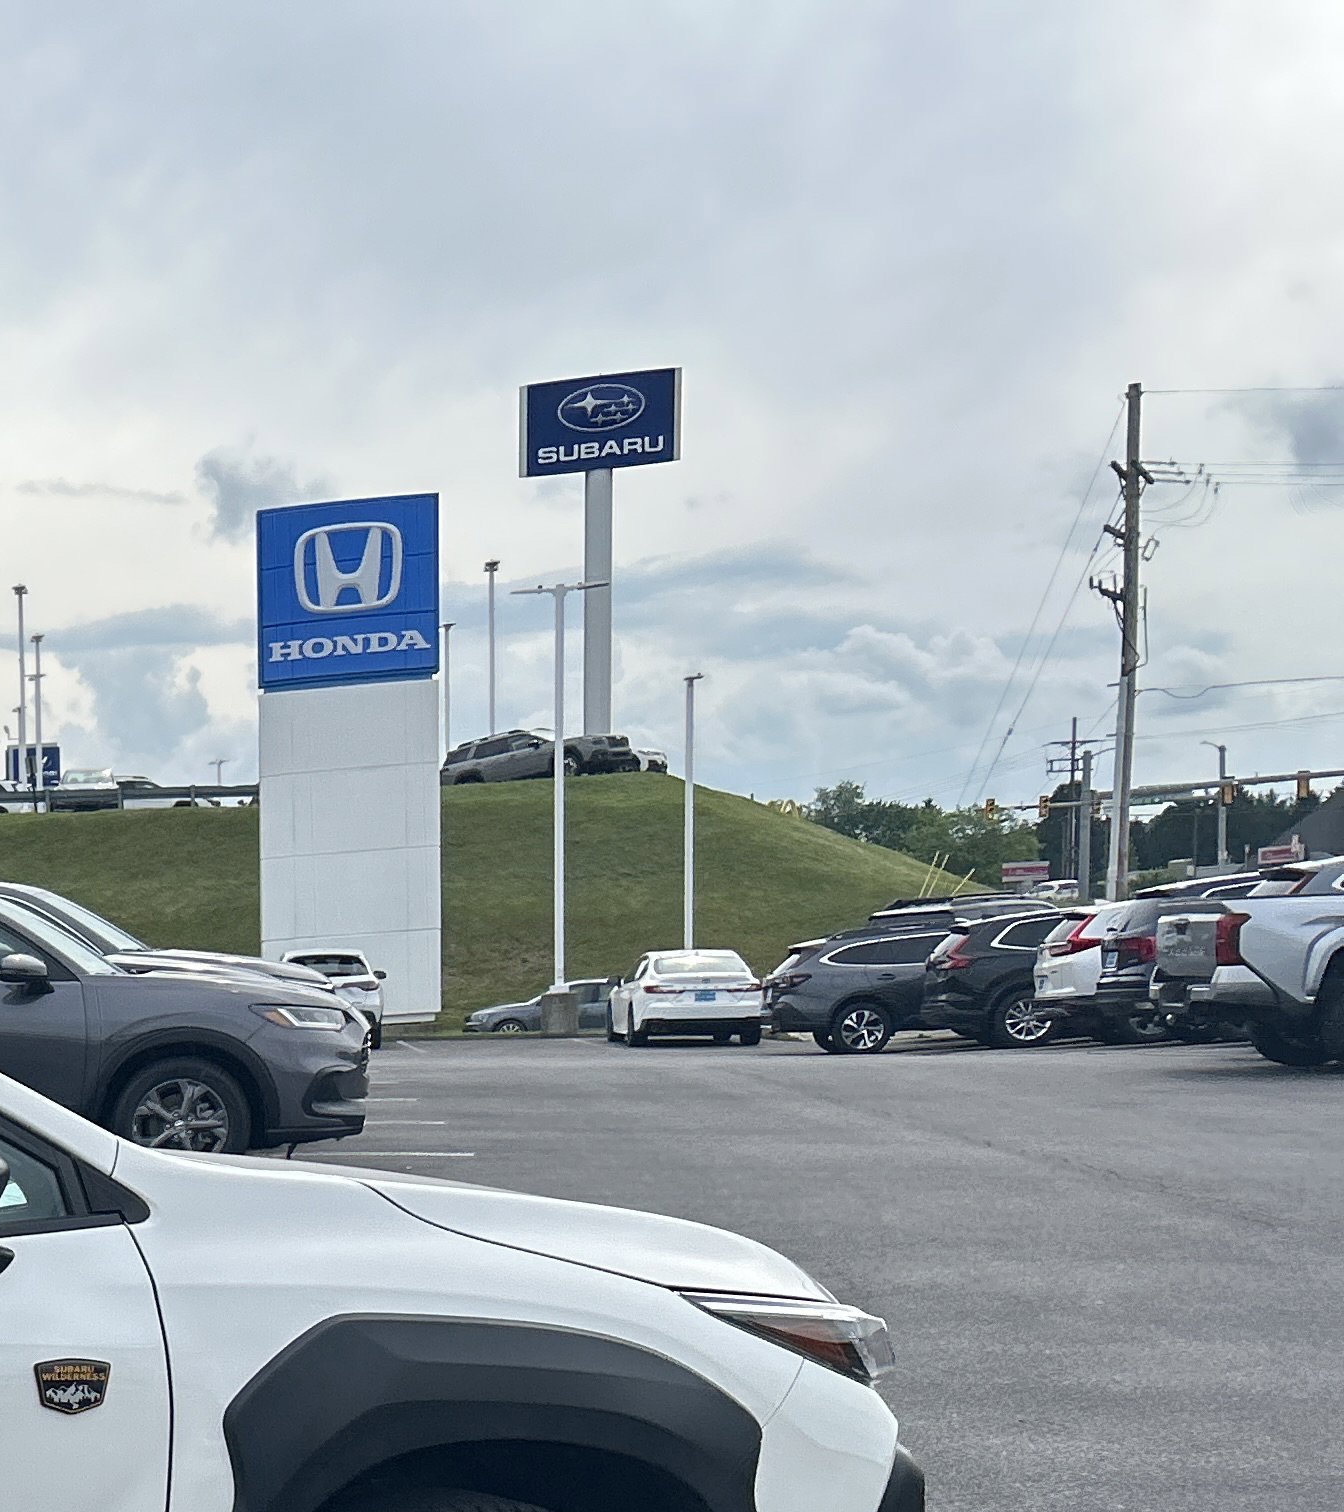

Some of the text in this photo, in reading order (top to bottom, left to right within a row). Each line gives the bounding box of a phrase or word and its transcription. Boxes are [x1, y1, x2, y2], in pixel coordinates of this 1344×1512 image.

[537, 435, 664, 464] SUBARU
[268, 629, 431, 663] HONDA
[41, 1372, 106, 1381] WILDERNESS
[53, 1365, 95, 1373] SUBARU
